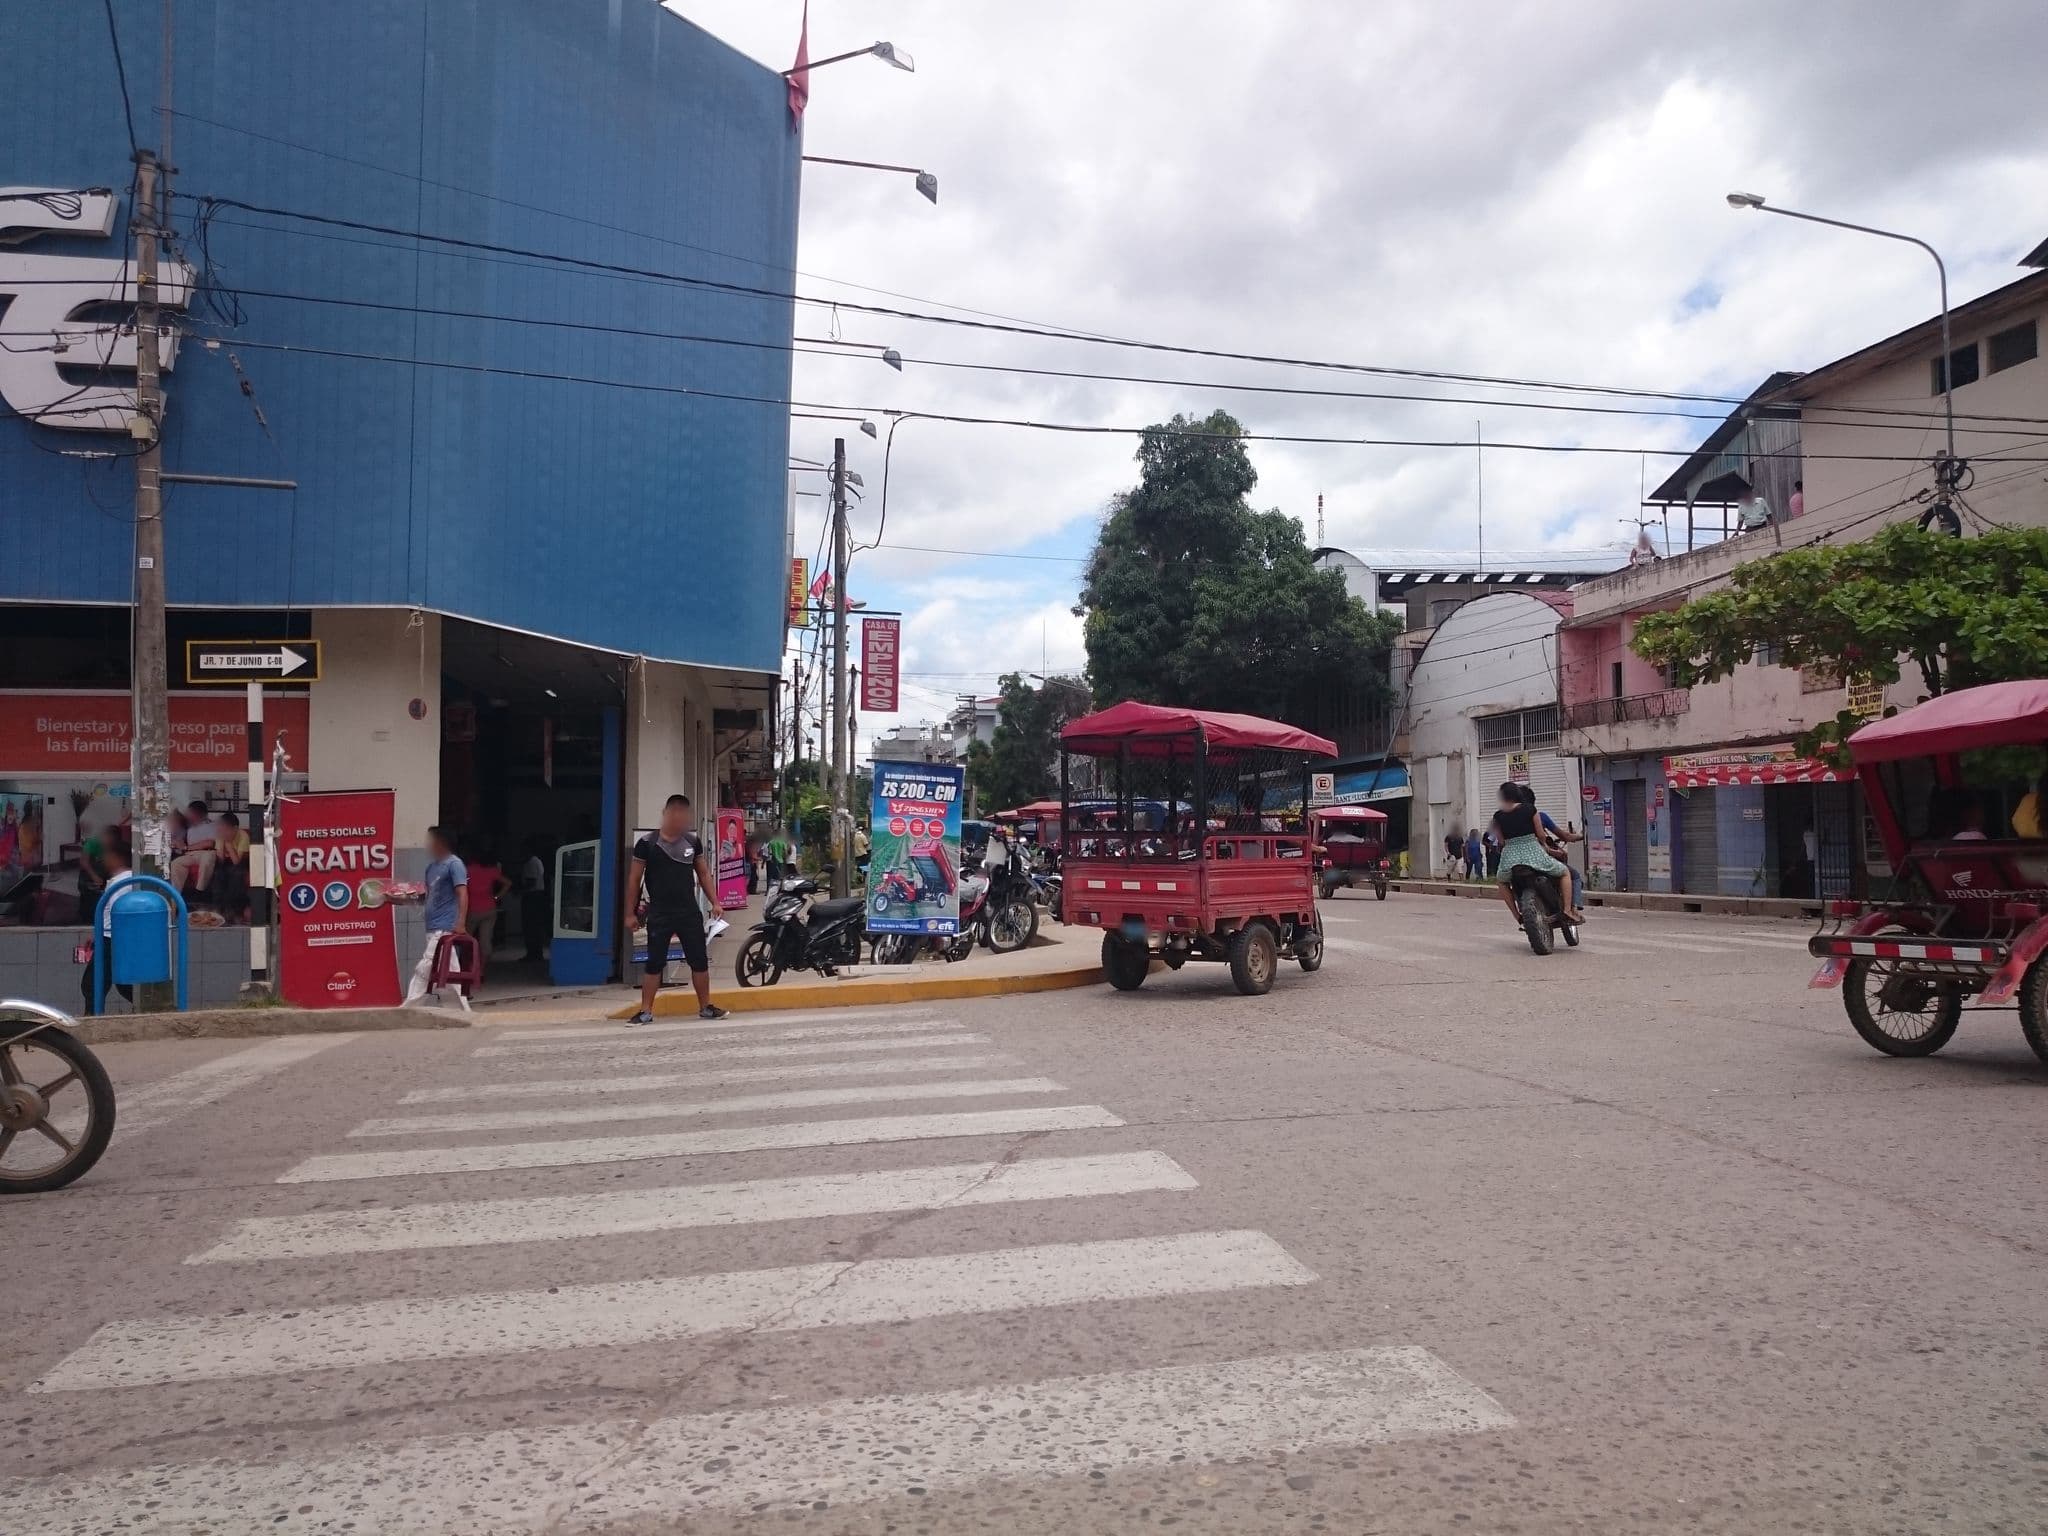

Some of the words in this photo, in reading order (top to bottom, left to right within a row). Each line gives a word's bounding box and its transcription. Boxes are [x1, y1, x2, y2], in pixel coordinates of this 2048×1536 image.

[865, 620, 885, 629] CASA
[887, 621, 898, 629] DE
[203, 656, 217, 666] JR.
[219, 656, 225, 666] 7
[226, 656, 237, 666] DE
[237, 656, 263, 666] JUNIO
[36, 718, 115, 733] Bienestar
[118, 722, 128, 737] y
[209, 723, 246, 741] para
[47, 737, 69, 752] las
[168, 739, 235, 757] Pucallpa
[1512, 754, 1524, 764] SE
[1319, 779, 1327, 788] E
[881, 782, 898, 798] ZS
[899, 783, 926, 799] 200
[934, 785, 956, 801] CM
[903, 805, 945, 815] ZONGSHEN
[296, 828, 328, 839] REDES
[330, 827, 377, 837] SOCIALES
[285, 844, 390, 875] GRATIS
[304, 923, 320, 932] CON
[321, 922, 333, 932] TU
[334, 921, 376, 931] POSTPAGO
[327, 979, 354, 991] Claro
